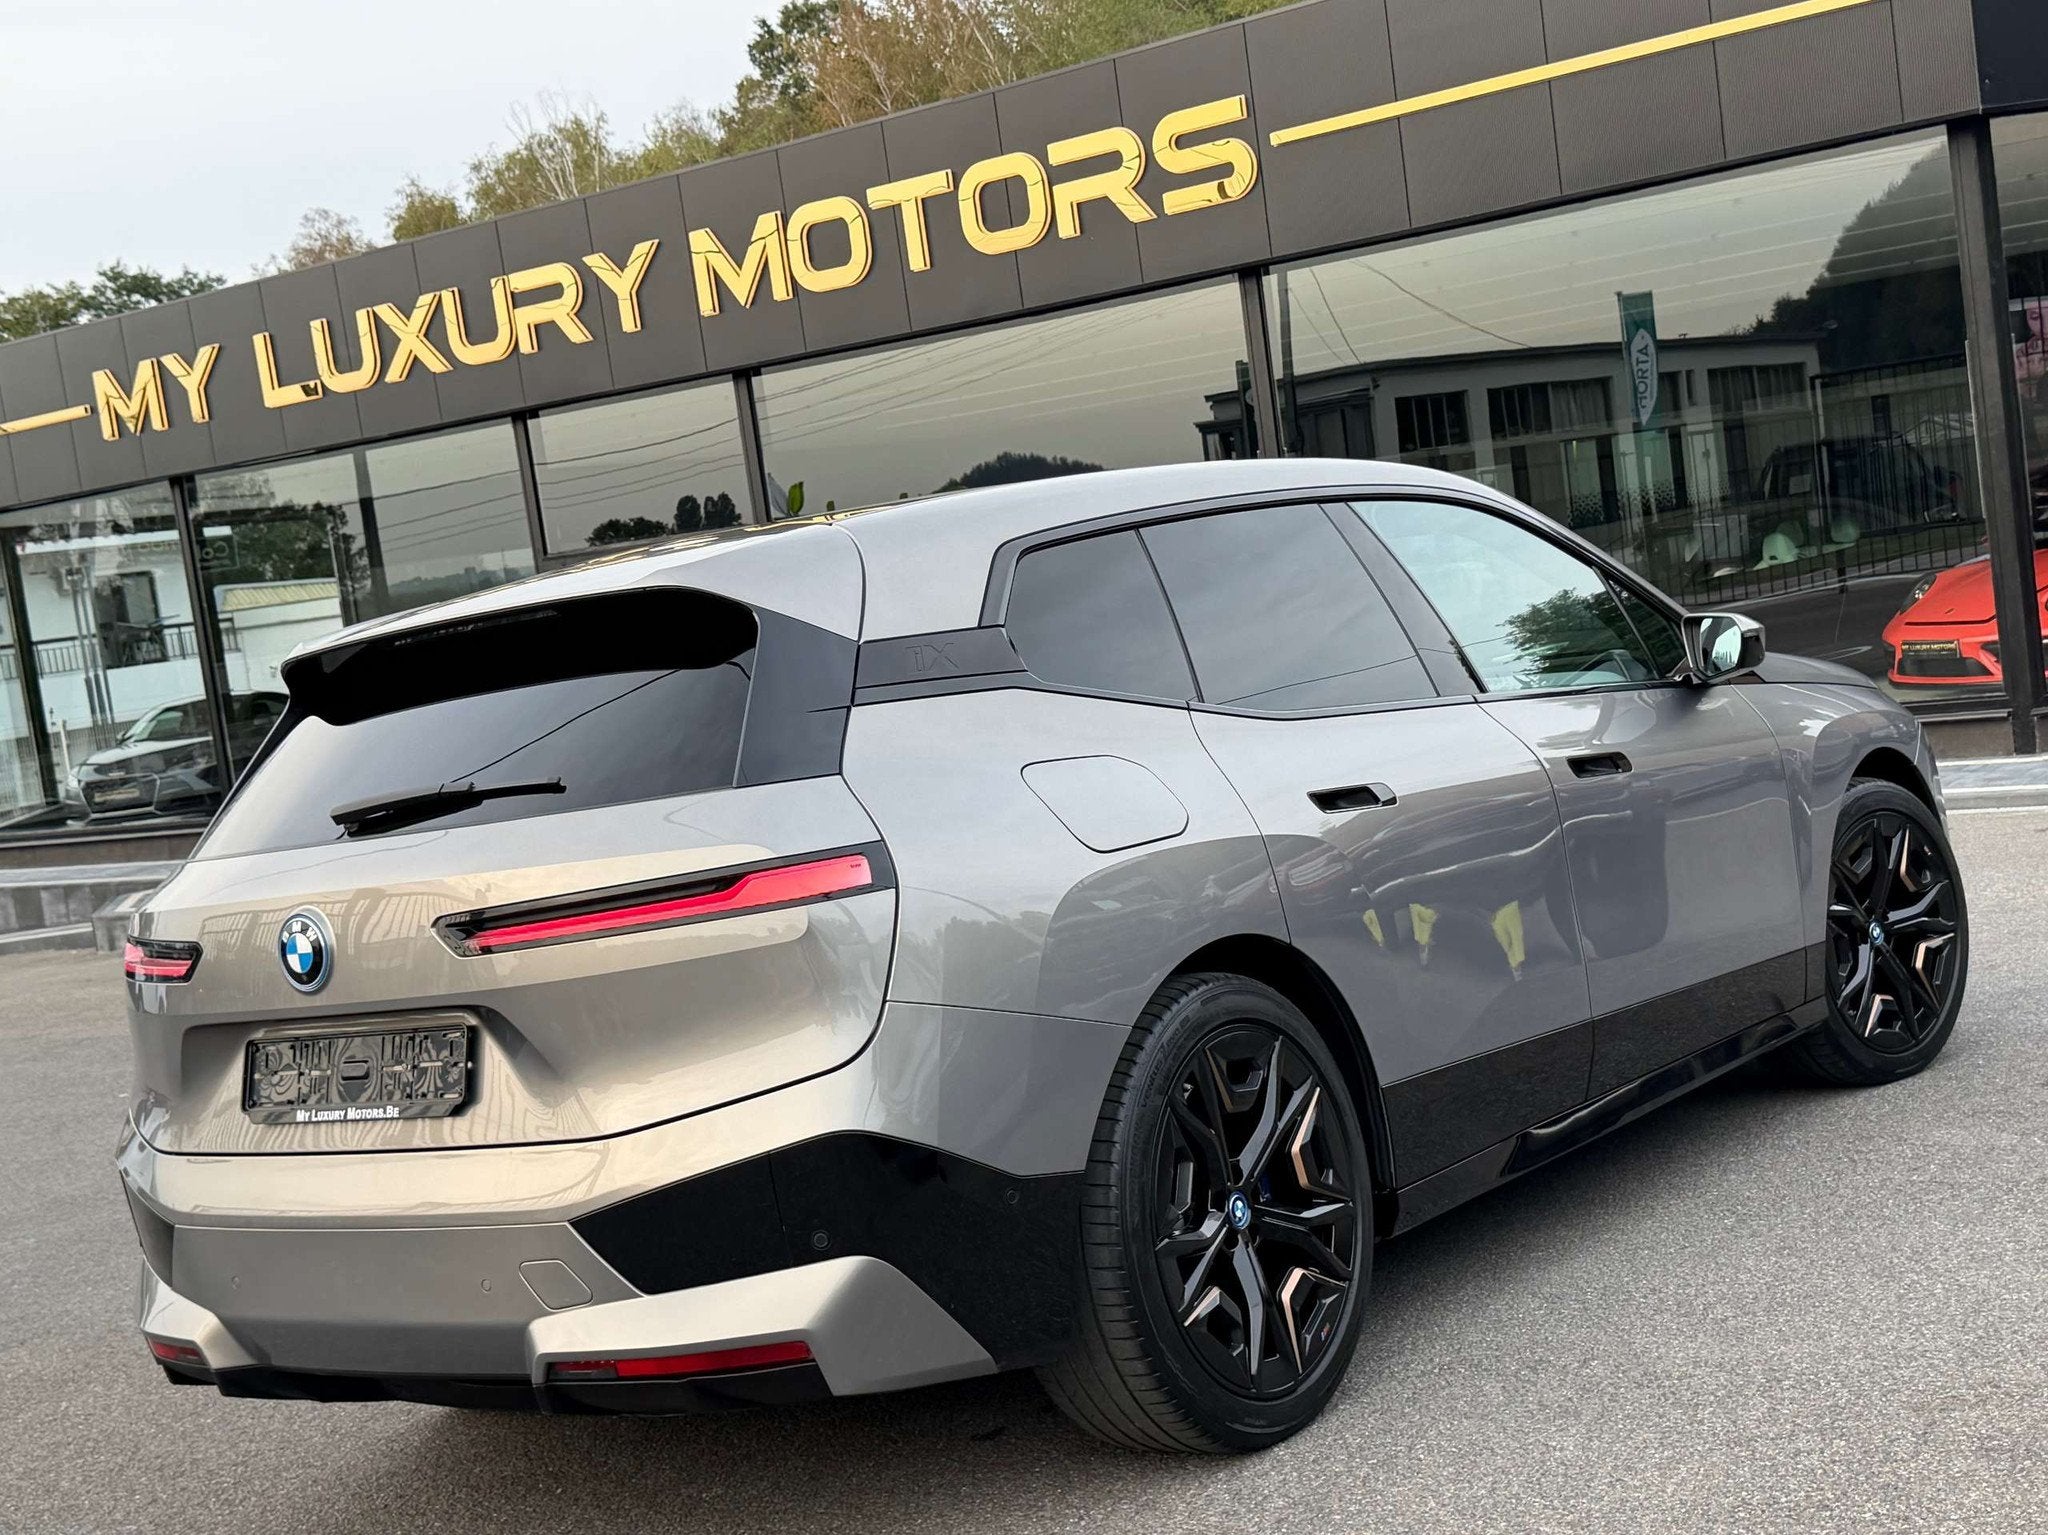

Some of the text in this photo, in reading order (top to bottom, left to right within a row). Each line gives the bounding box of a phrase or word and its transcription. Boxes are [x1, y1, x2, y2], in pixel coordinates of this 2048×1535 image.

[92, 94, 1258, 441] MY LUXURY MOTORS
[282, 920, 317, 943] BMW
